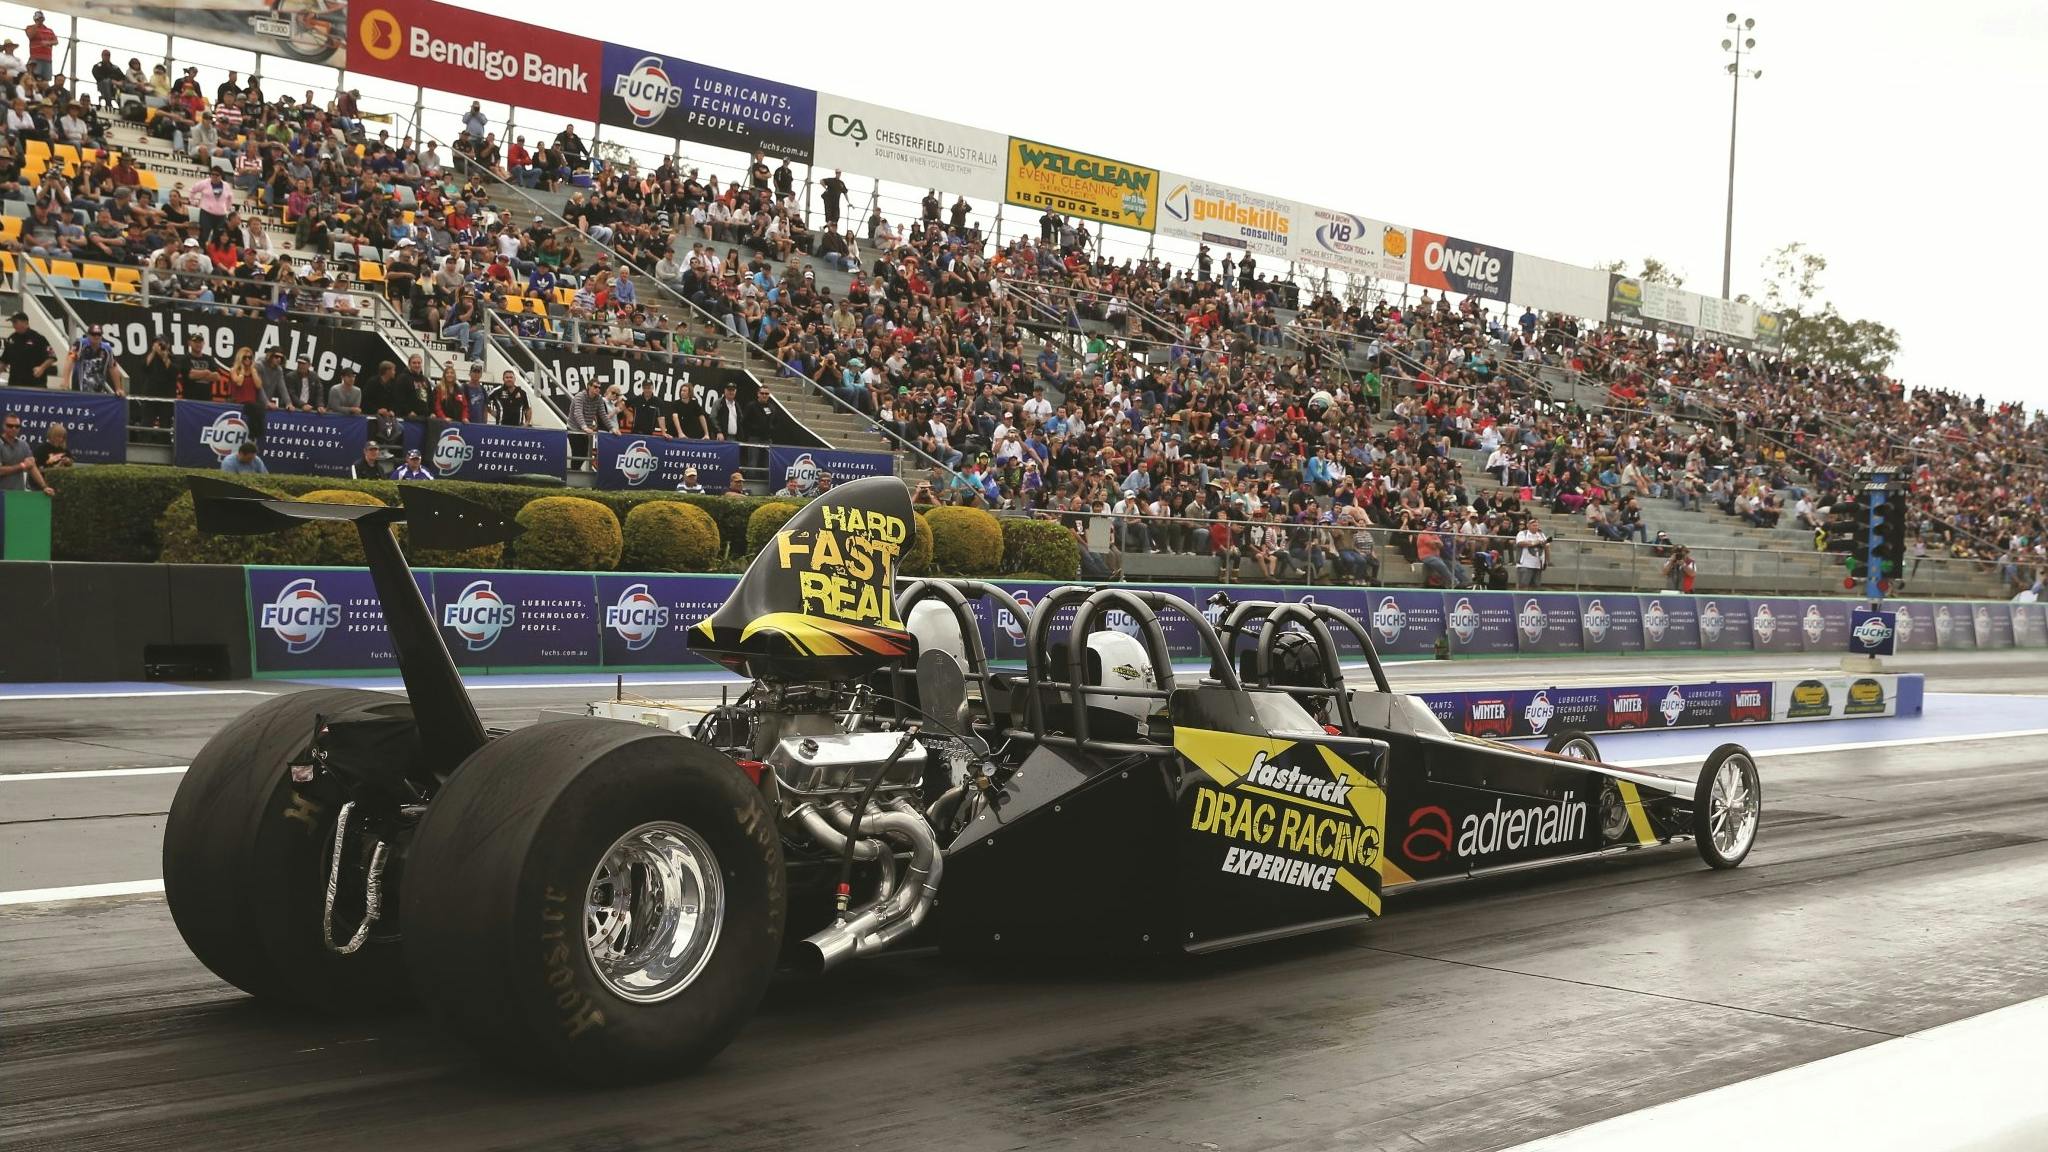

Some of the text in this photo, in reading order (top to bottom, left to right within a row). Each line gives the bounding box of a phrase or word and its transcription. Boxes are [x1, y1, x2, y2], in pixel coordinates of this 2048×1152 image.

[410, 26, 588, 93] Bendigo Bank
[615, 75, 682, 107] FUCHS
[694, 77, 791, 110] LUBRICANTS.
[692, 95, 794, 128] TECHNOLOGY.
[688, 112, 750, 135] PEOPLE.
[759, 140, 809, 158] fuchs.com.au
[875, 128, 998, 167] CHESTERFIELD AUSTRALIA
[875, 148, 908, 162] SOLUTIONS
[909, 155, 926, 167] WHEN
[928, 159, 941, 169] YOU
[957, 164, 972, 176] THEM
[1019, 144, 1151, 191] WILCLEAN
[1019, 167, 1119, 199] EVENT CLEANING
[1016, 191, 1120, 219] 1800 004 255
[1193, 198, 1289, 233] goldskills
[1240, 226, 1288, 246] consulting
[1330, 222, 1352, 243] WB
[6, 404, 96, 417] LUBRICANTS.
[203, 428, 248, 443] FUCH
[266, 422, 342, 435] LUBRICANTS.
[265, 436, 344, 449] TECHNOLOGY.
[481, 437, 546, 449] LUBRICANTS.
[262, 449, 310, 460] PEOPLE.
[436, 445, 474, 460] UCHS
[480, 451, 547, 461] TECHNOLOGY.
[665, 449, 720, 460] LUBRICANTS.
[478, 463, 518, 473] PEOPLE.
[617, 458, 658, 470] FUCHS
[663, 461, 722, 471] TECHNOLOGY.
[828, 462, 877, 471] LUBRICANTS.
[822, 505, 906, 544] HARD
[777, 528, 901, 587] FAST
[799, 570, 907, 632] REAL
[264, 607, 340, 626] FUCHS
[447, 607, 514, 625] FUCHS
[608, 609, 668, 626] FUCHS
[1374, 615, 1406, 627] FUCHS
[1450, 616, 1480, 627] FUCHS
[1520, 616, 1547, 627] FUCHS
[1585, 616, 1610, 627] FUCHS
[1645, 616, 1669, 627] FUCHS
[1701, 616, 1724, 627] FUCHS
[1855, 628, 1892, 638] FUCHS
[1558, 695, 1599, 703] LUBRICANTS.
[1613, 698, 1643, 712] WINTER
[1660, 699, 1686, 711] FUCHS
[1685, 700, 1722, 708] TECHNOLOGY.
[1736, 693, 1761, 707] WINTER
[1472, 704, 1506, 719] WINTER
[1525, 706, 1554, 718] FUCHS
[1556, 705, 1599, 714] TECHNOLOGY.
[1563, 715, 1588, 723] PEOPLE.
[1247, 752, 1353, 805] fastrack
[1191, 787, 1379, 867] DRAG RACING
[1457, 791, 1587, 857] adrenalin
[1221, 846, 1337, 892] EXPERIENCE
